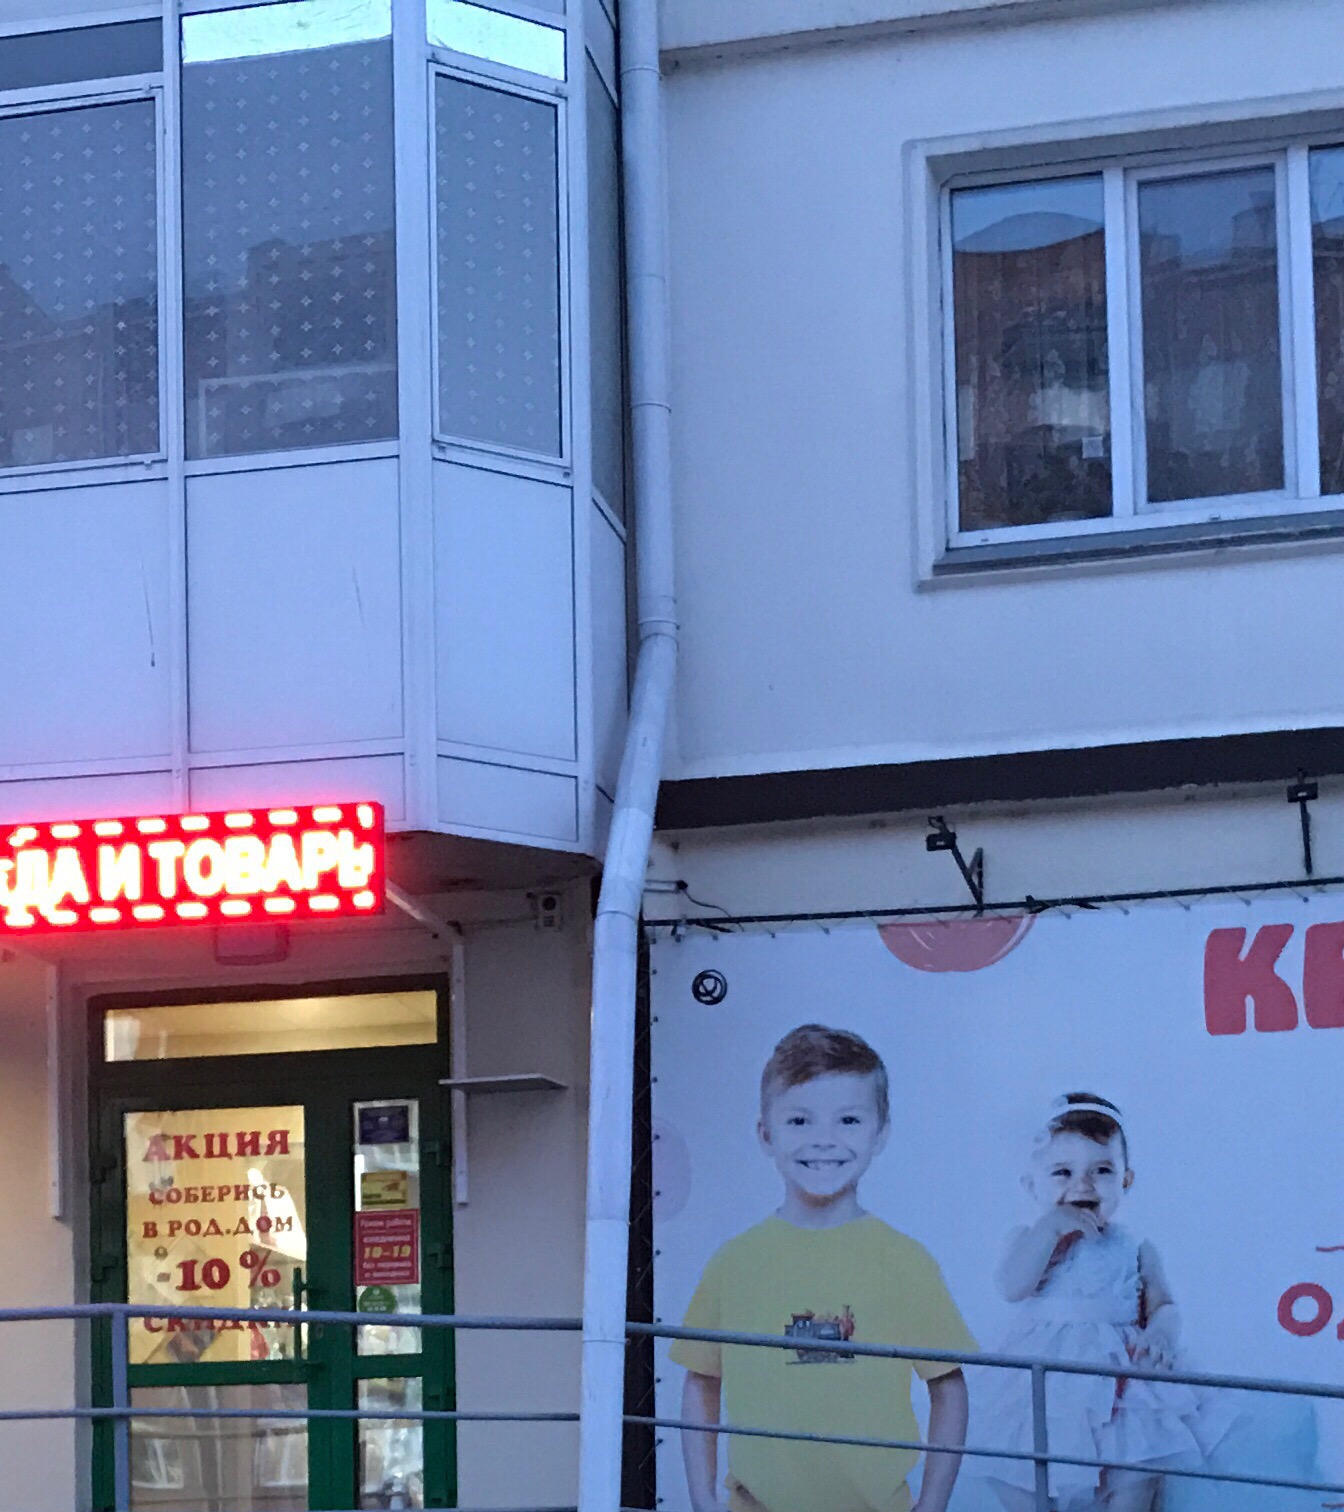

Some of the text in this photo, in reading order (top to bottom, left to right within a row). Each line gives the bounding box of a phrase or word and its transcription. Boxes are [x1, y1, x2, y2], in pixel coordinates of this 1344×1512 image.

[98, 843, 141, 901] И
[142, 1130, 290, 1162] АКЦИЯ
[148, 1183, 285, 1205] СОБЕРИСЬ
[142, 1220, 158, 1238] В
